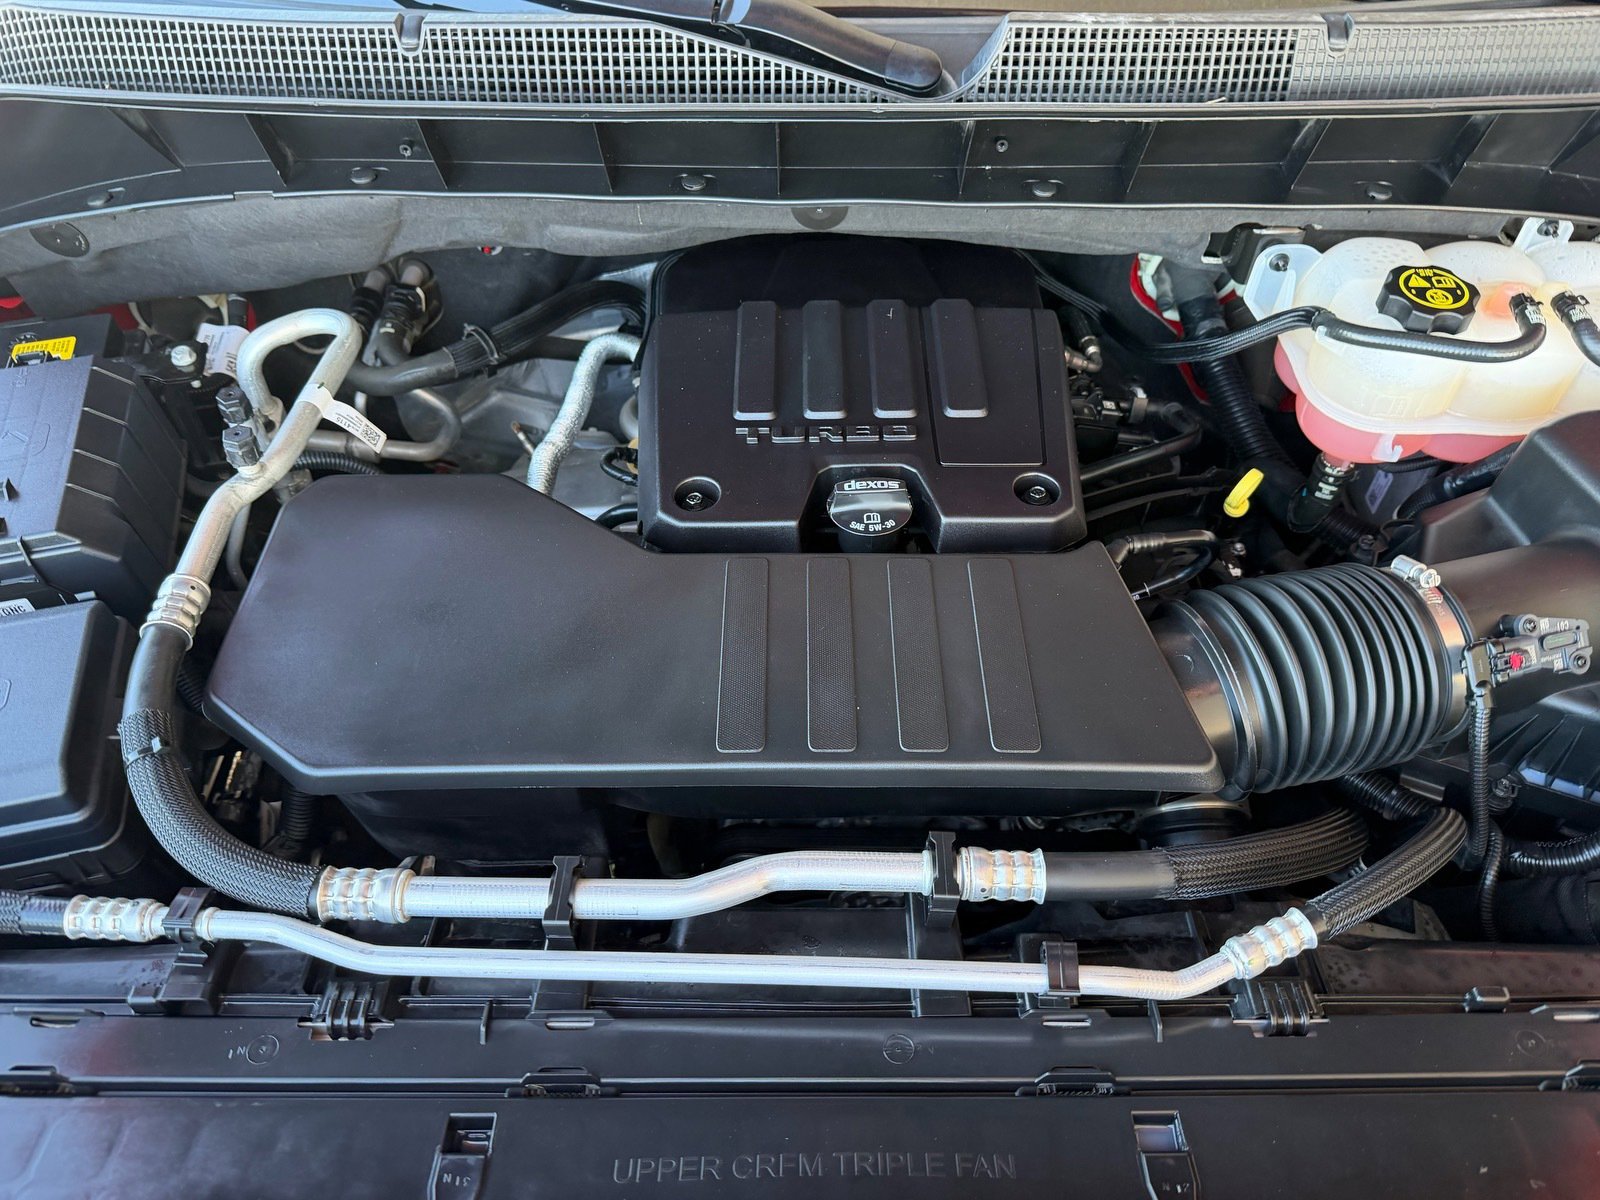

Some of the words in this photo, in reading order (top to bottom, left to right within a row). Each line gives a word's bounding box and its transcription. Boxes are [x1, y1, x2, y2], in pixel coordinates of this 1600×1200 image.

[735, 425, 917, 444] TURBO
[843, 480, 901, 491] dexos
[849, 520, 865, 531] SAE
[868, 519, 896, 532] 5W-30
[613, 1156, 723, 1184] UPPER
[732, 1153, 824, 1179] CRFM
[833, 1152, 947, 1178] TRIPLE
[955, 1152, 1018, 1180] FAN
